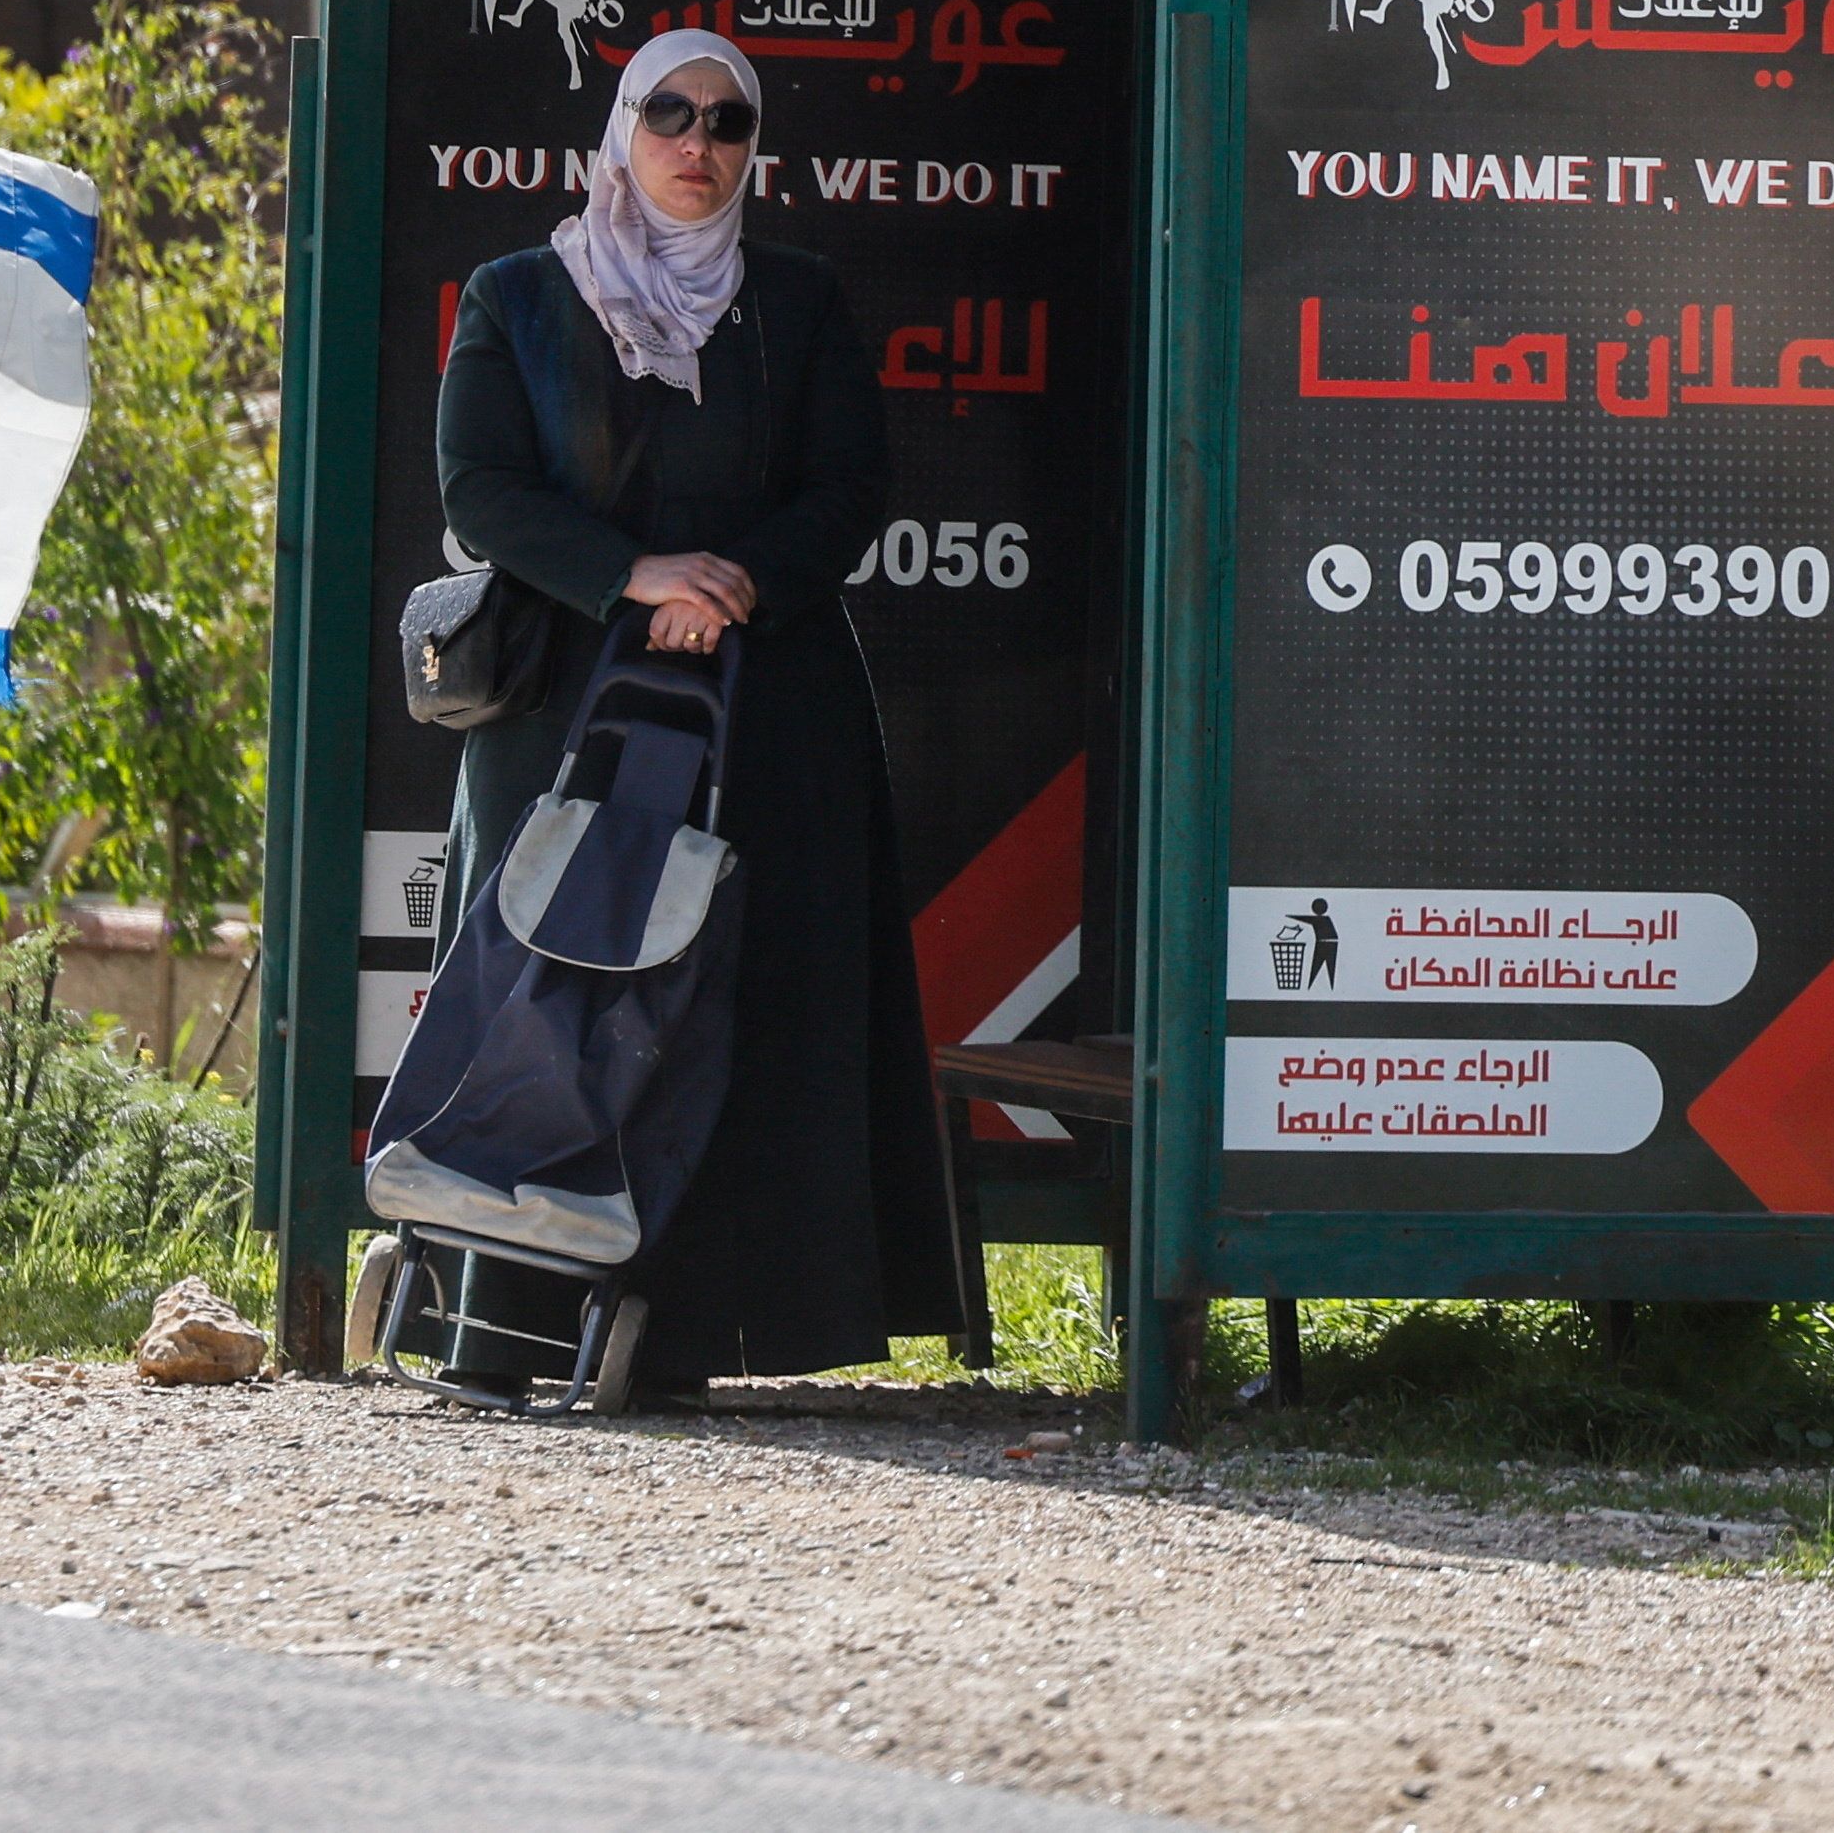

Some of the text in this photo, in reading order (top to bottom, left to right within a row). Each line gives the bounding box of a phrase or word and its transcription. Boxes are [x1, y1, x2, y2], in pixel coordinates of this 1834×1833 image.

[430, 145, 545, 189] YOU
[811, 157, 897, 201] WE
[917, 161, 992, 203] DO
[1011, 164, 1060, 206] IT
[1288, 151, 1411, 197] YOU
[1432, 153, 1588, 200] NAME
[1607, 157, 1673, 210] IT,
[1695, 159, 1787, 205] WE
[1300, 298, 1567, 401] هنا
[1385, 907, 1678, 945] الرجاء المحافظة
[1385, 956, 1676, 992] على نظافة المكان
[1278, 1049, 1550, 1088] الرجاء عدم وضع
[1278, 1101, 1548, 1142] الملصقات عليها
